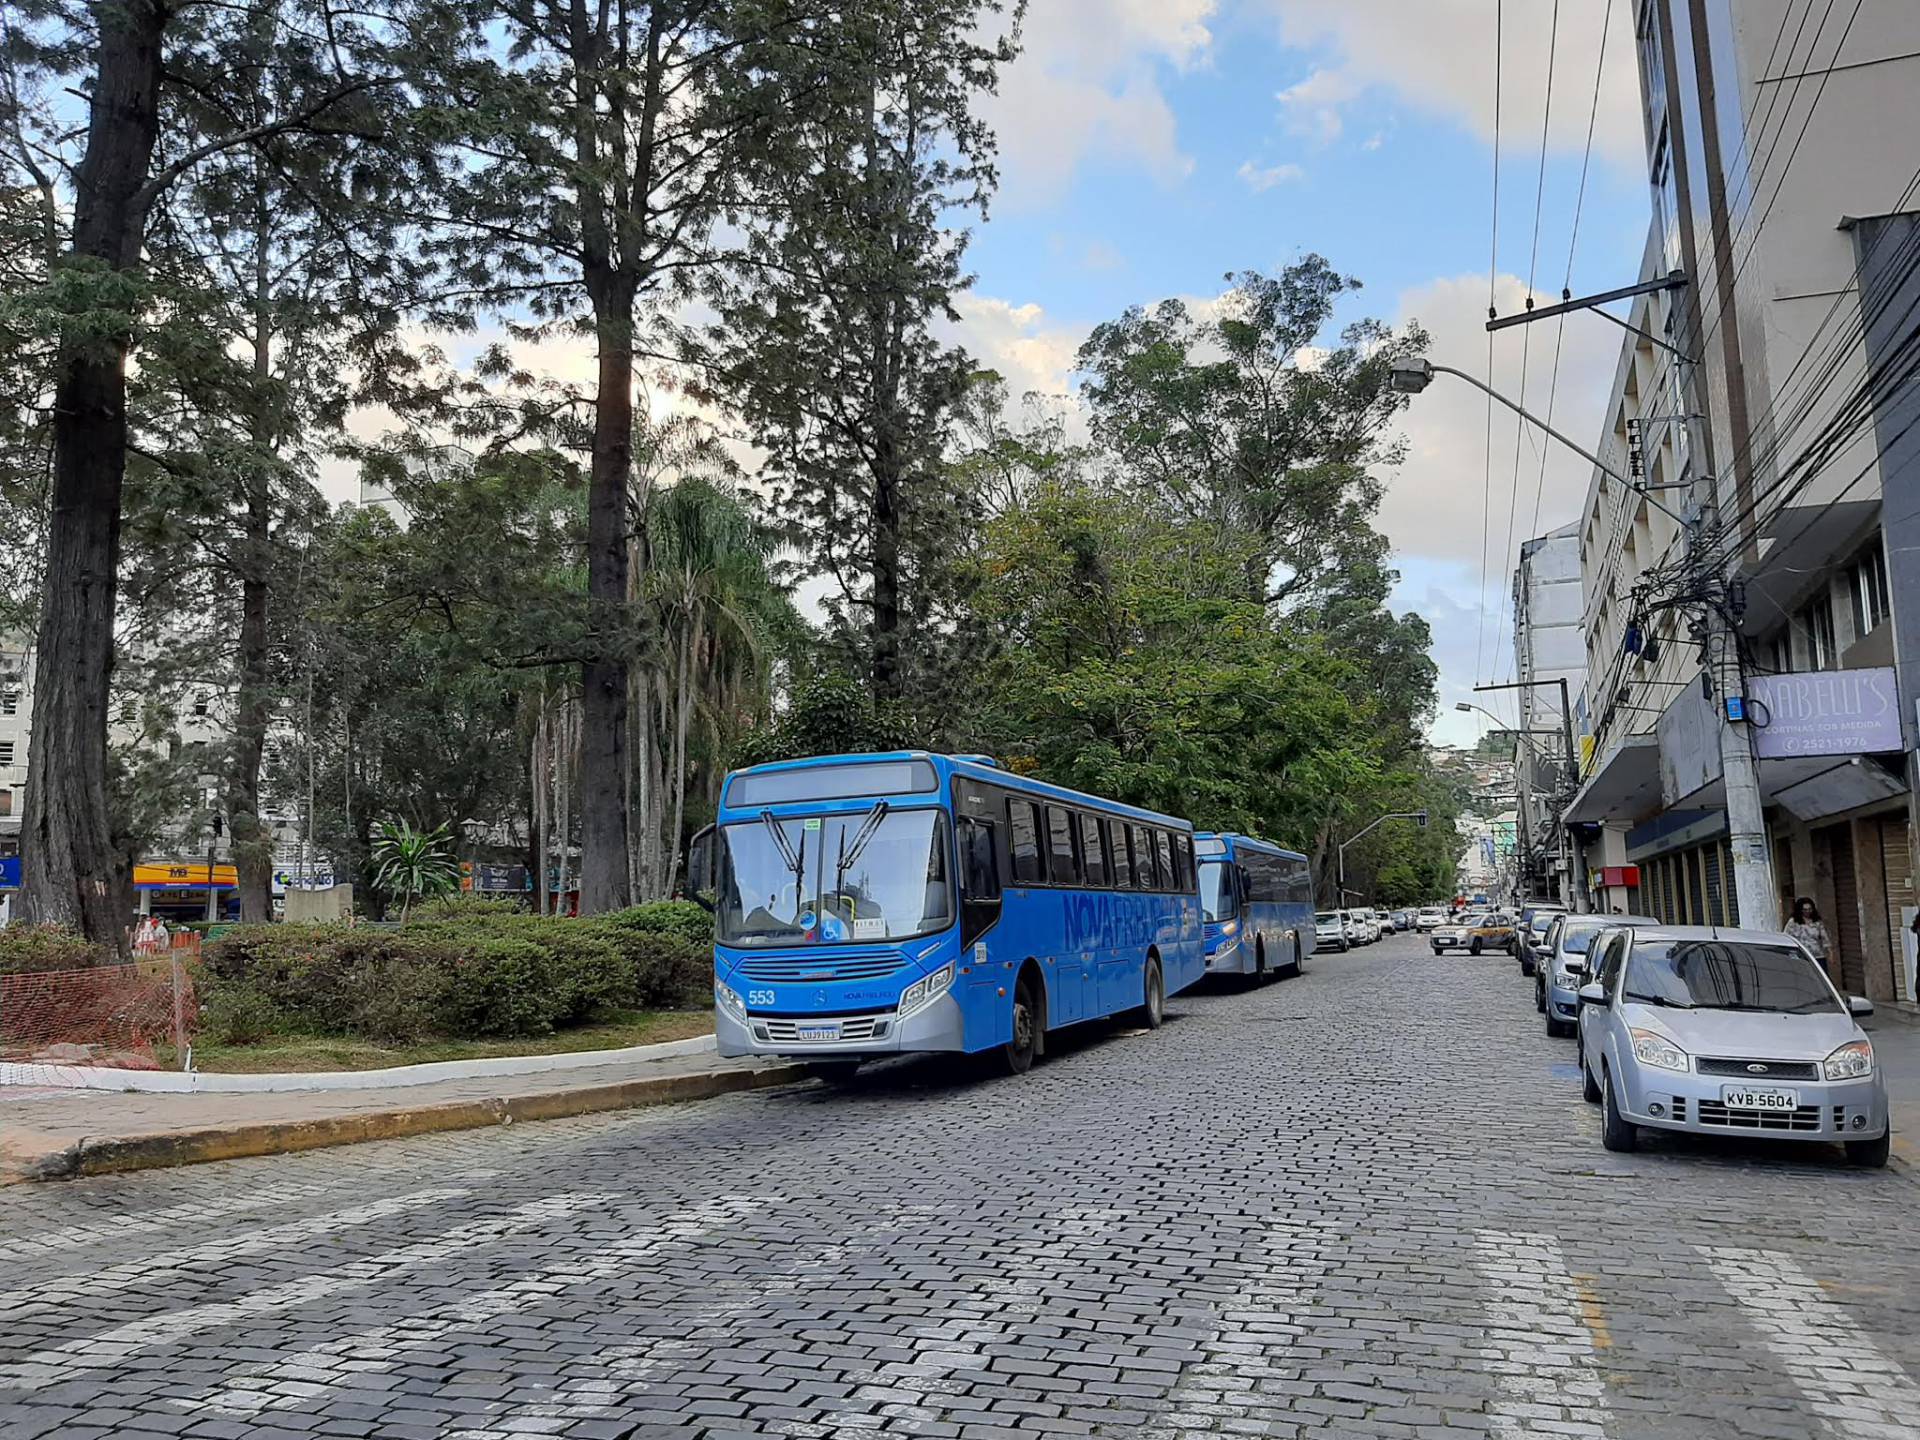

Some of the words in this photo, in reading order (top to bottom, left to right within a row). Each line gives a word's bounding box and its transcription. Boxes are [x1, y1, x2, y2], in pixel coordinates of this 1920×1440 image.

[1754, 673, 1889, 721] MABELLI'S
[1764, 724, 1814, 735] CORTINAS
[1817, 722, 1838, 732] SOB
[1841, 720, 1882, 731] MEDIDA
[1802, 736, 1867, 749] 2521-1976
[748, 989, 776, 1005] 553
